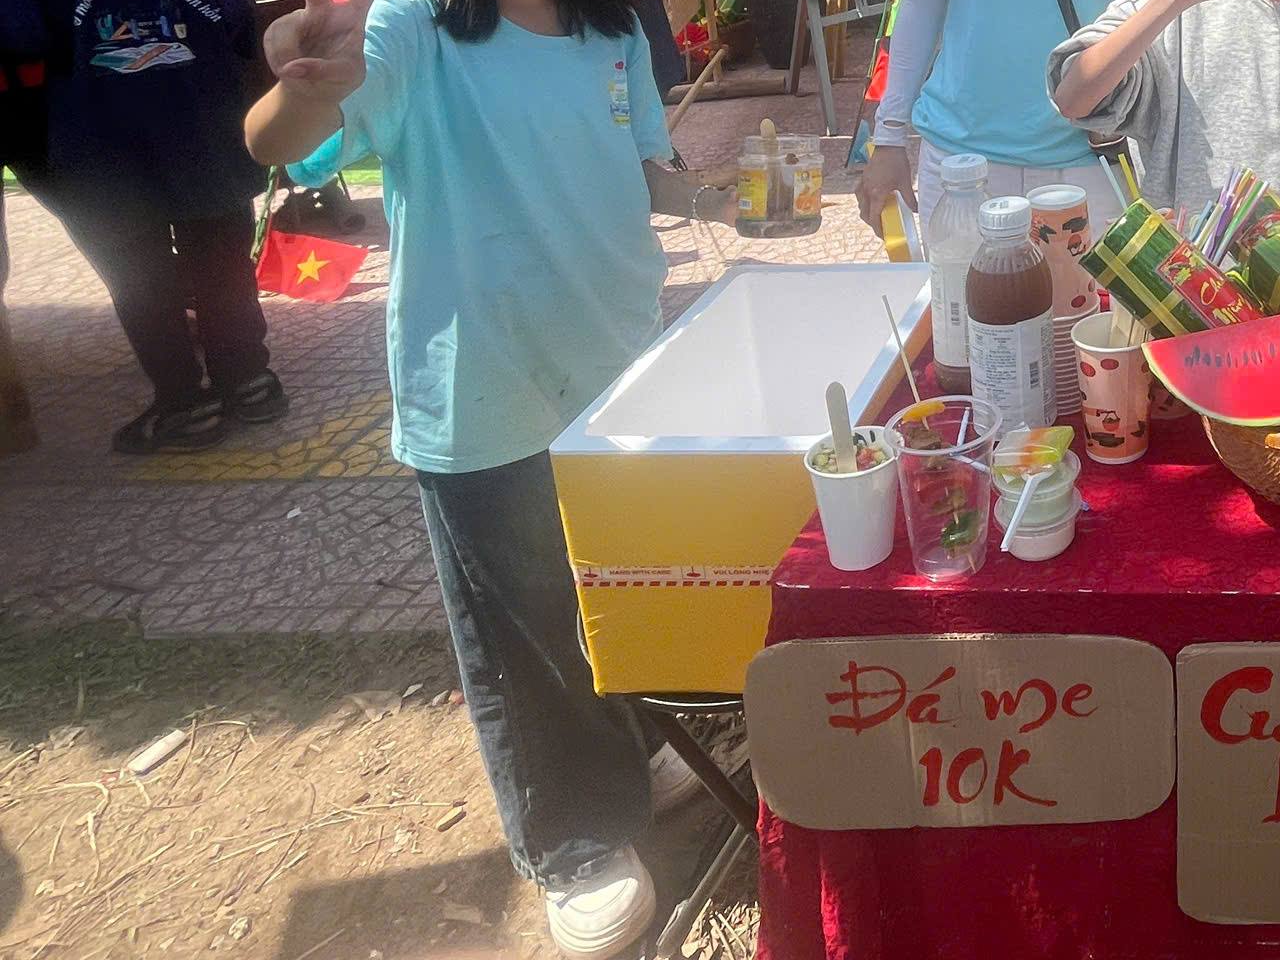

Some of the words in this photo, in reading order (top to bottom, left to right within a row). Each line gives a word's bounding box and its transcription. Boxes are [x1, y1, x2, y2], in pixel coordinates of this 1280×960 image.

[826, 660, 957, 736] Đá
[981, 678, 1099, 734] me
[918, 739, 1058, 807] 10K
